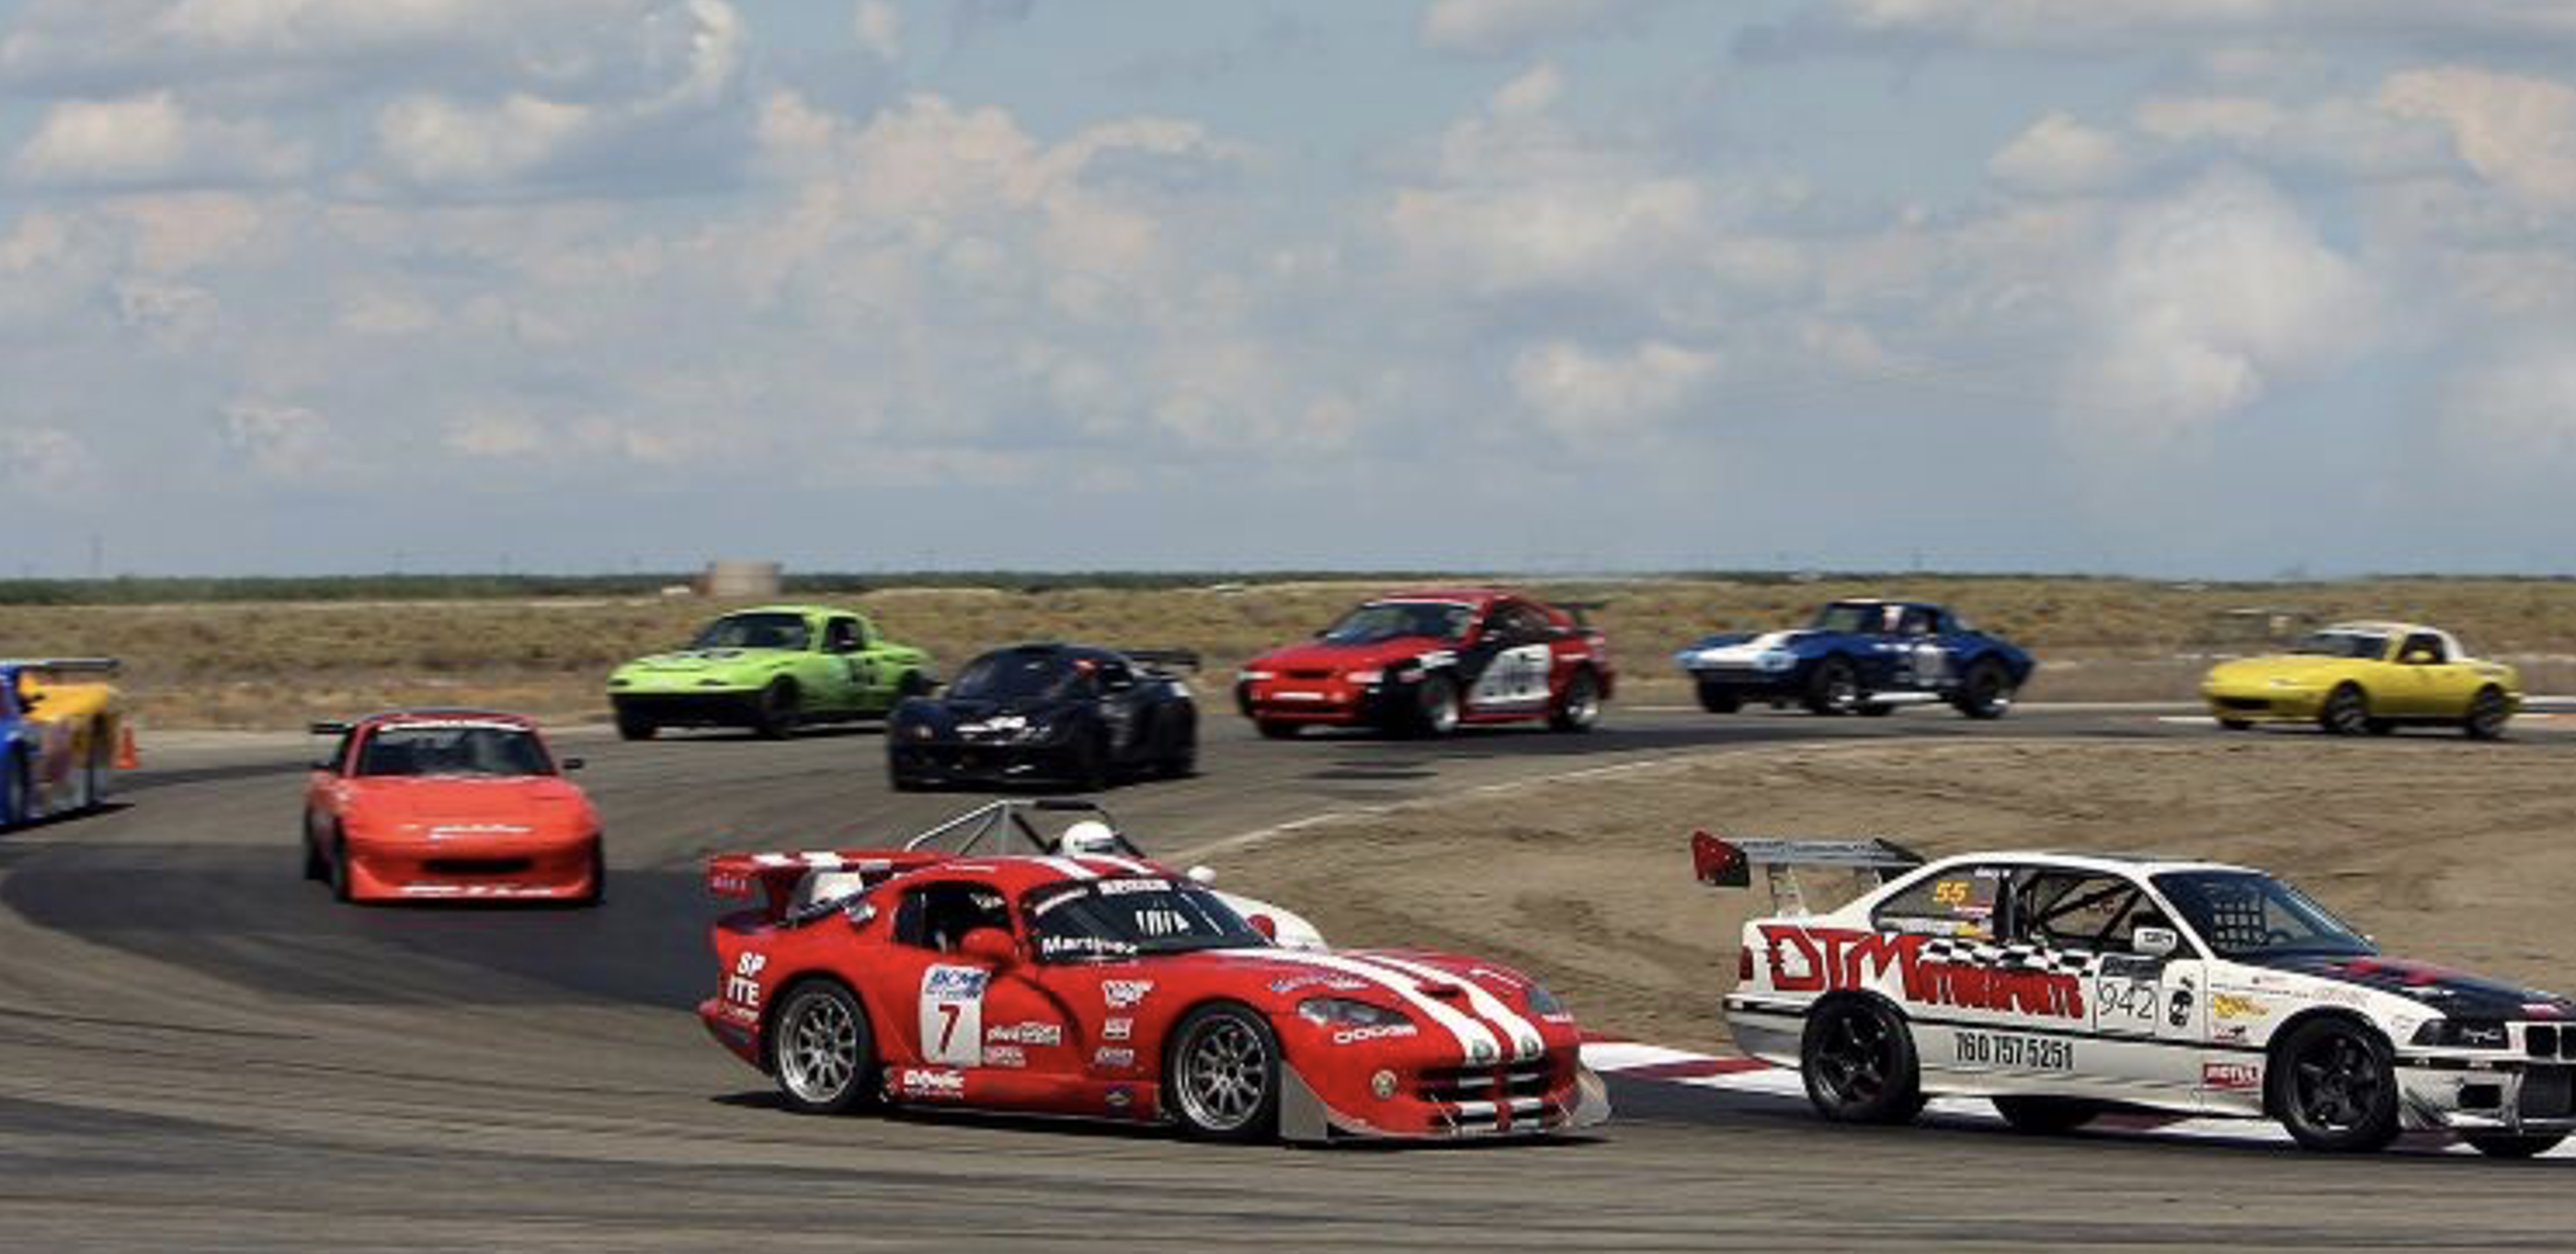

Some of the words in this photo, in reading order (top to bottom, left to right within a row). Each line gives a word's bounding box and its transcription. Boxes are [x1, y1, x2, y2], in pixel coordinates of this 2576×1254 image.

[1935, 883, 1968, 902] 55
[2098, 983, 2154, 1020] 942
[938, 1003, 961, 1054] 7
[1955, 1032, 1989, 1062] 760
[1992, 1035, 2023, 1065] 757
[2026, 1038, 2074, 1070] 5251
